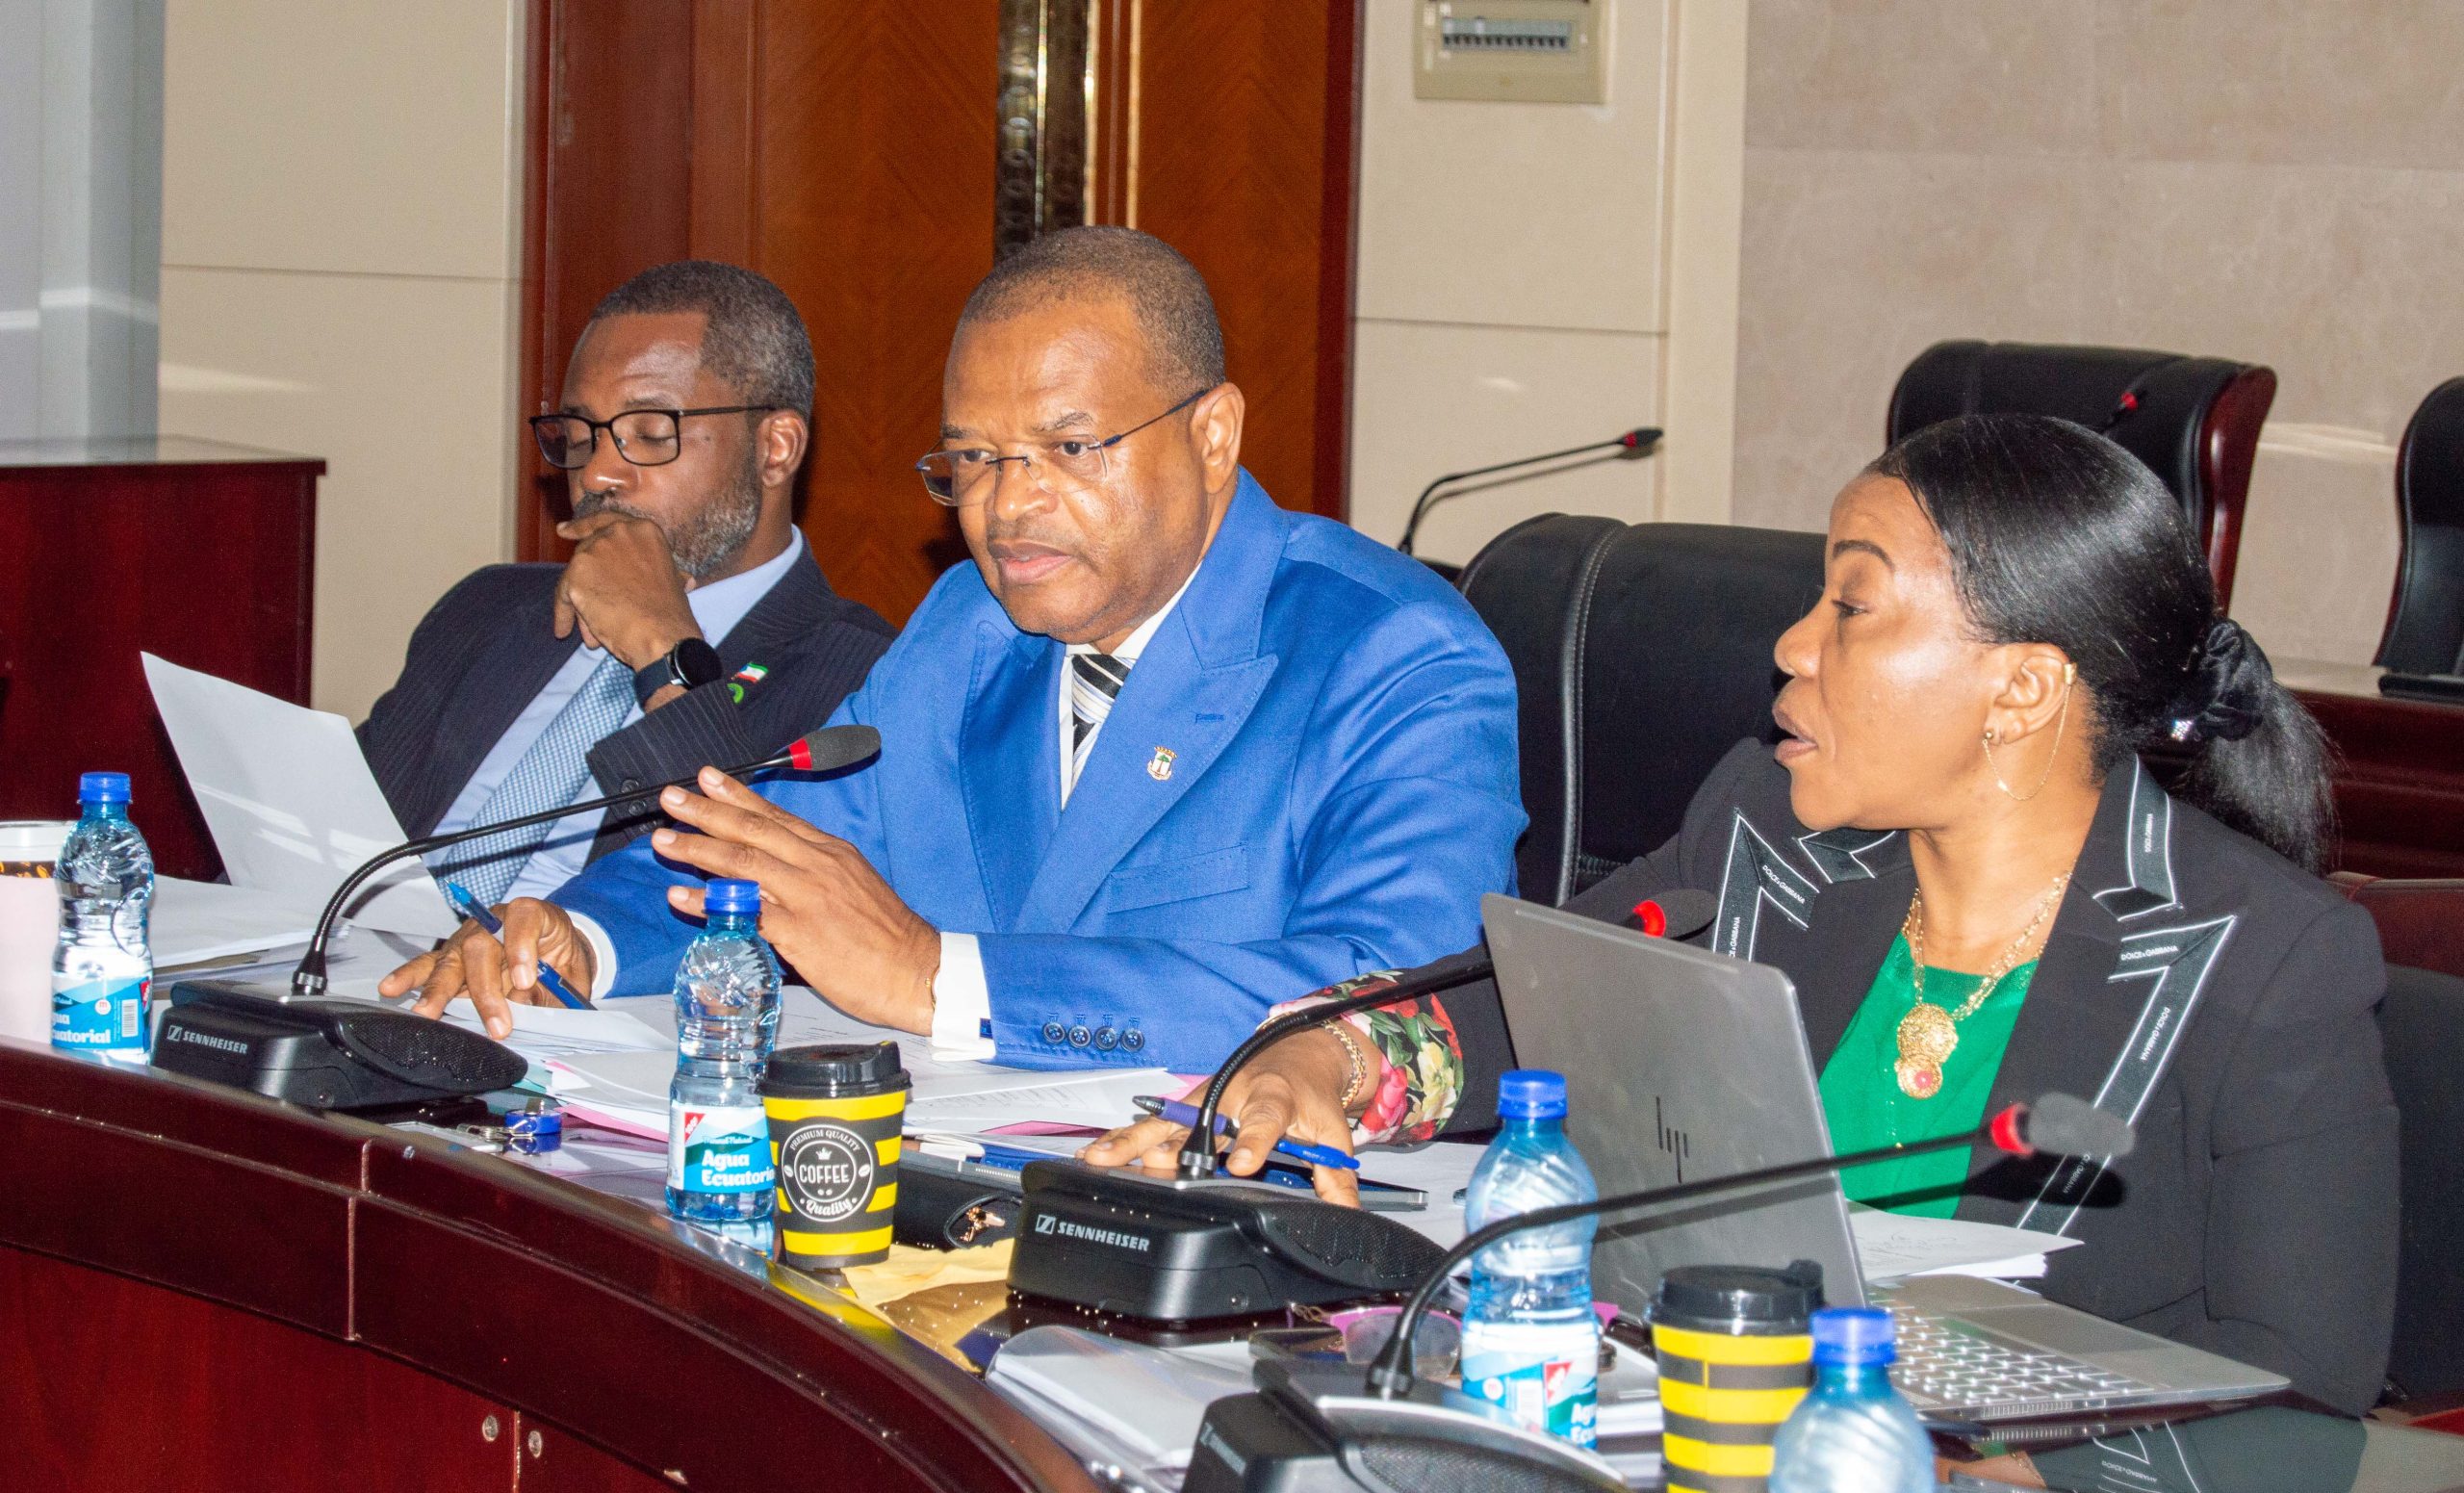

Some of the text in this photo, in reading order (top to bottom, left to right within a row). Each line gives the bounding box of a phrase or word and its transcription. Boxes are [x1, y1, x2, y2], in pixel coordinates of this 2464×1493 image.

[182, 1030, 248, 1054] SENNHEISER
[789, 1128, 861, 1152] PREMIUM QUALITY
[701, 1148, 751, 1172] Agua
[799, 1163, 850, 1185] COFFEE
[806, 1197, 854, 1217] Quality
[1058, 1221, 1151, 1252] SENNHEISER
